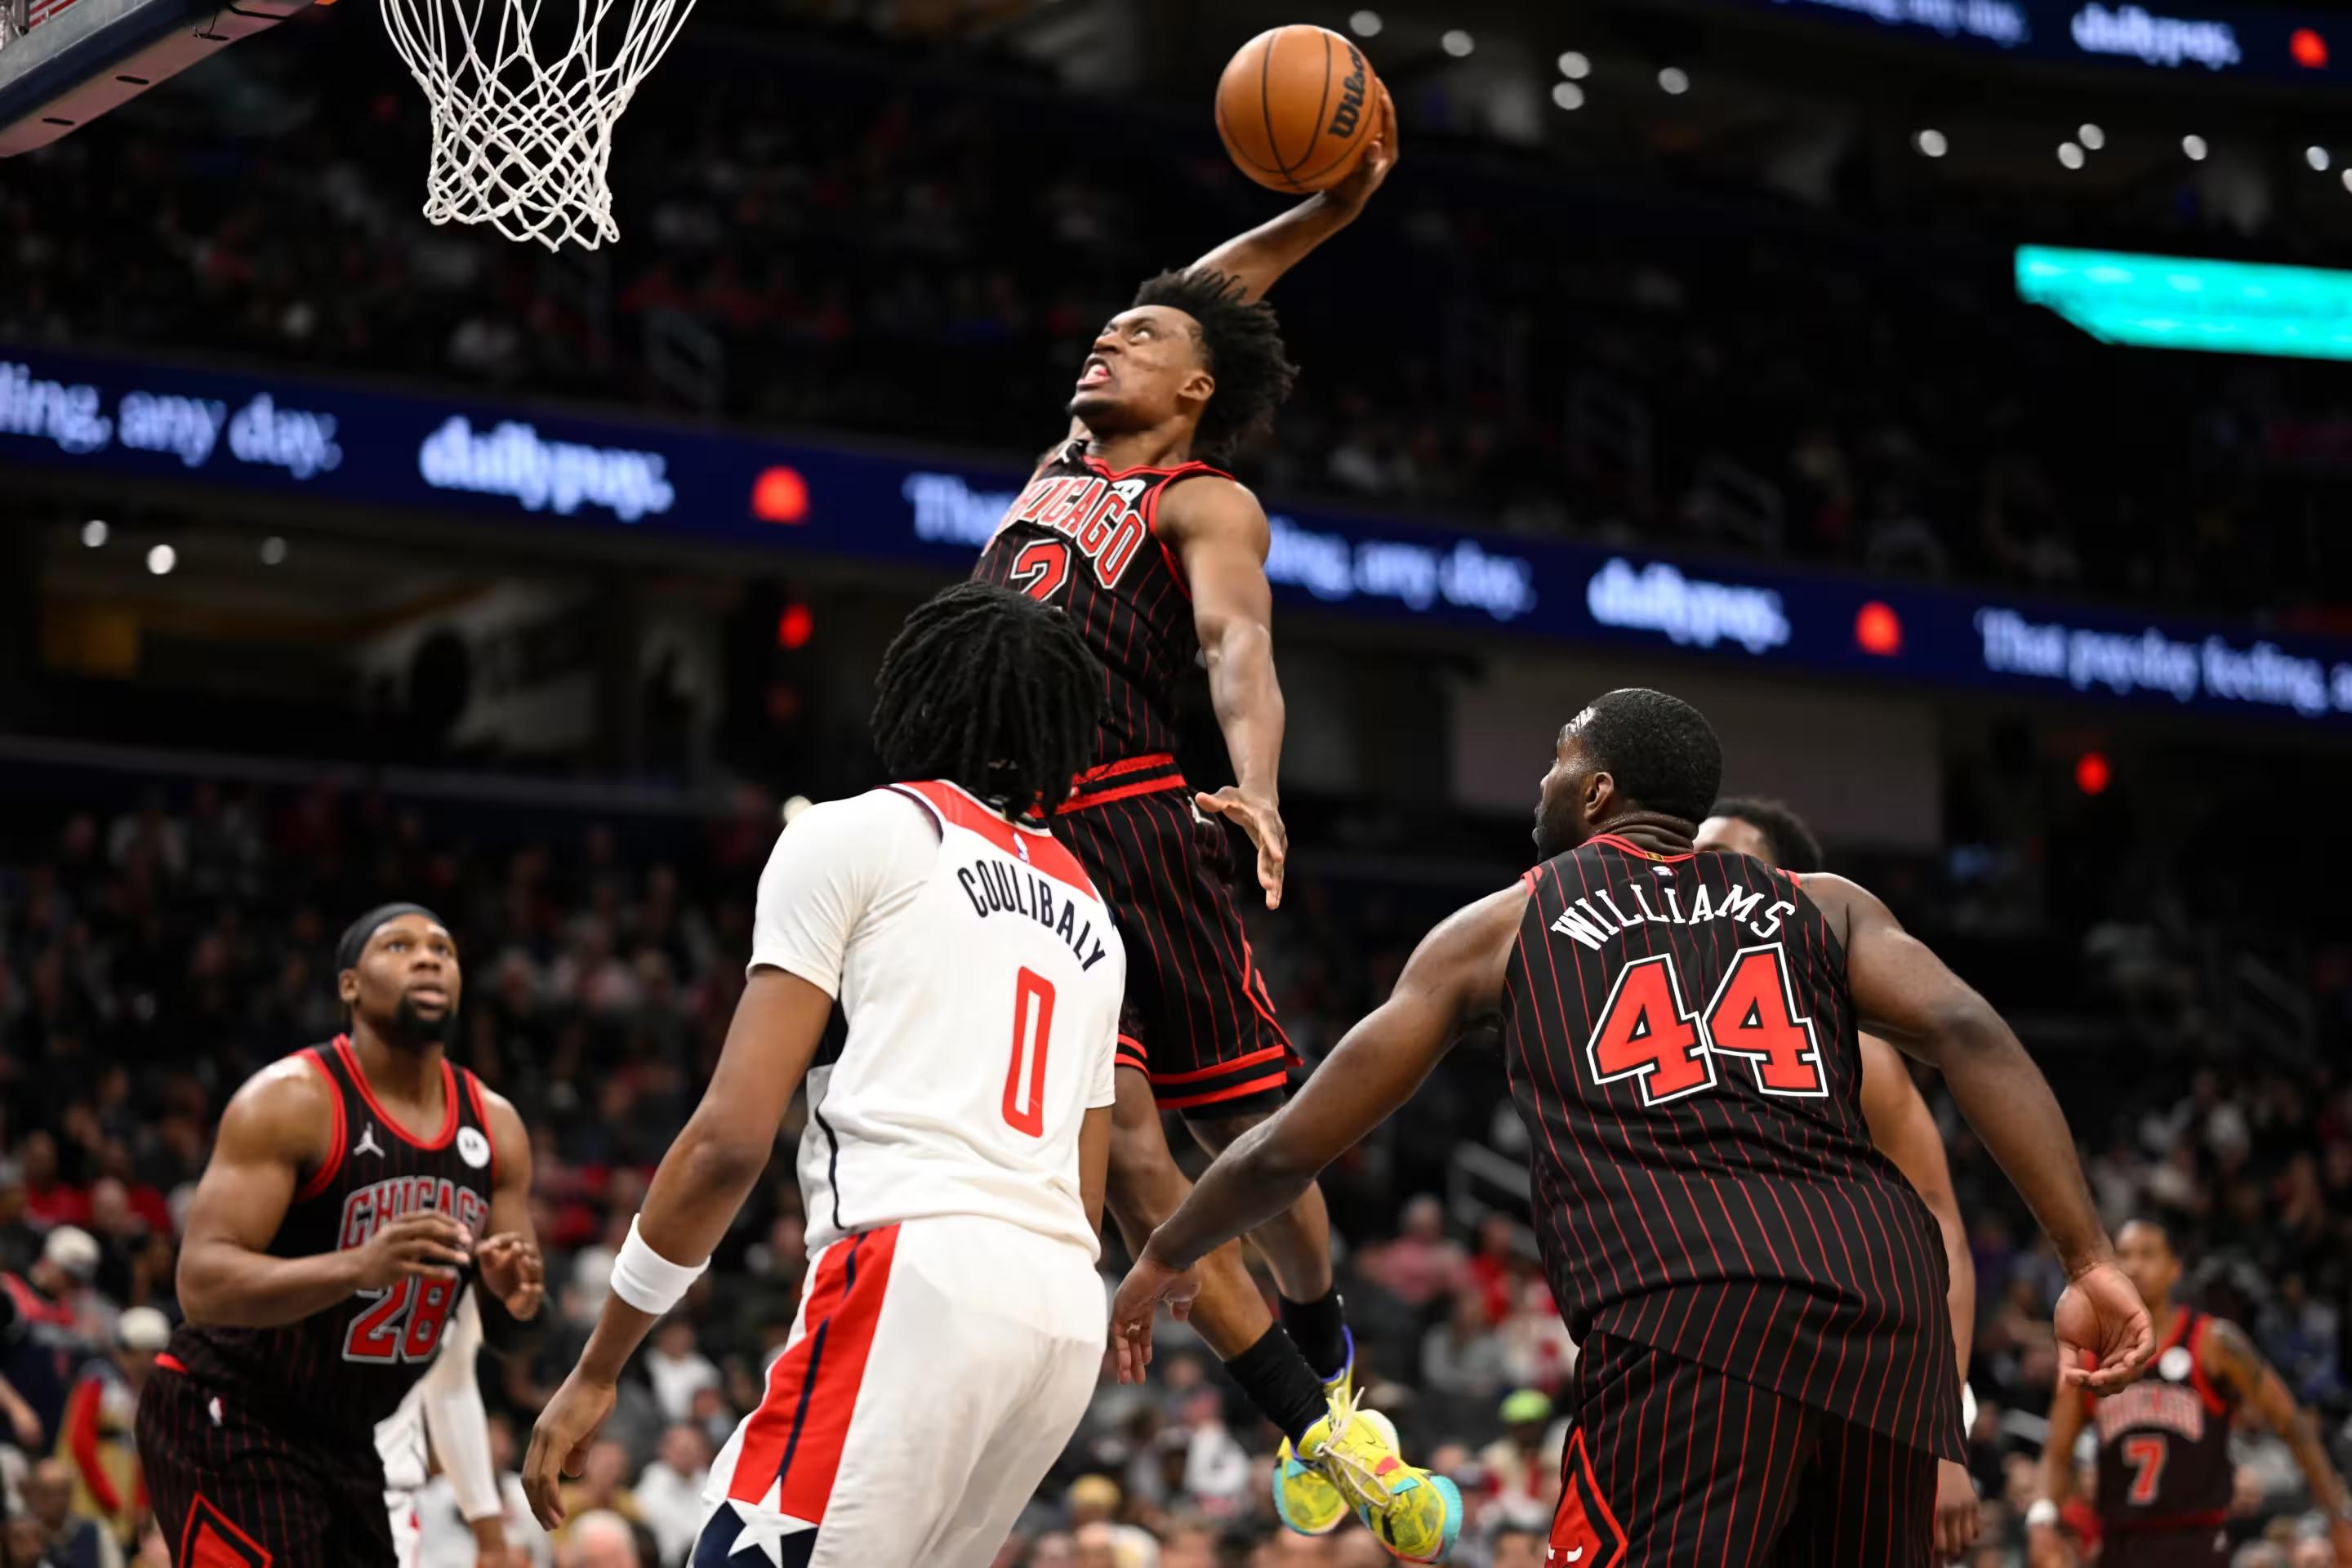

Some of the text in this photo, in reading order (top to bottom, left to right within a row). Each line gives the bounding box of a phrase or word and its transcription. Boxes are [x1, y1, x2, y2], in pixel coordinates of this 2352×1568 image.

[1010, 538, 1071, 603] 2
[957, 860, 1106, 972] COULIBALY
[1550, 884, 1796, 951] WILLIAMS
[1001, 964, 1057, 1138] 0
[1586, 941, 1829, 1107] 44
[341, 1266, 460, 1365] 28
[2123, 1435, 2167, 1505] 7
